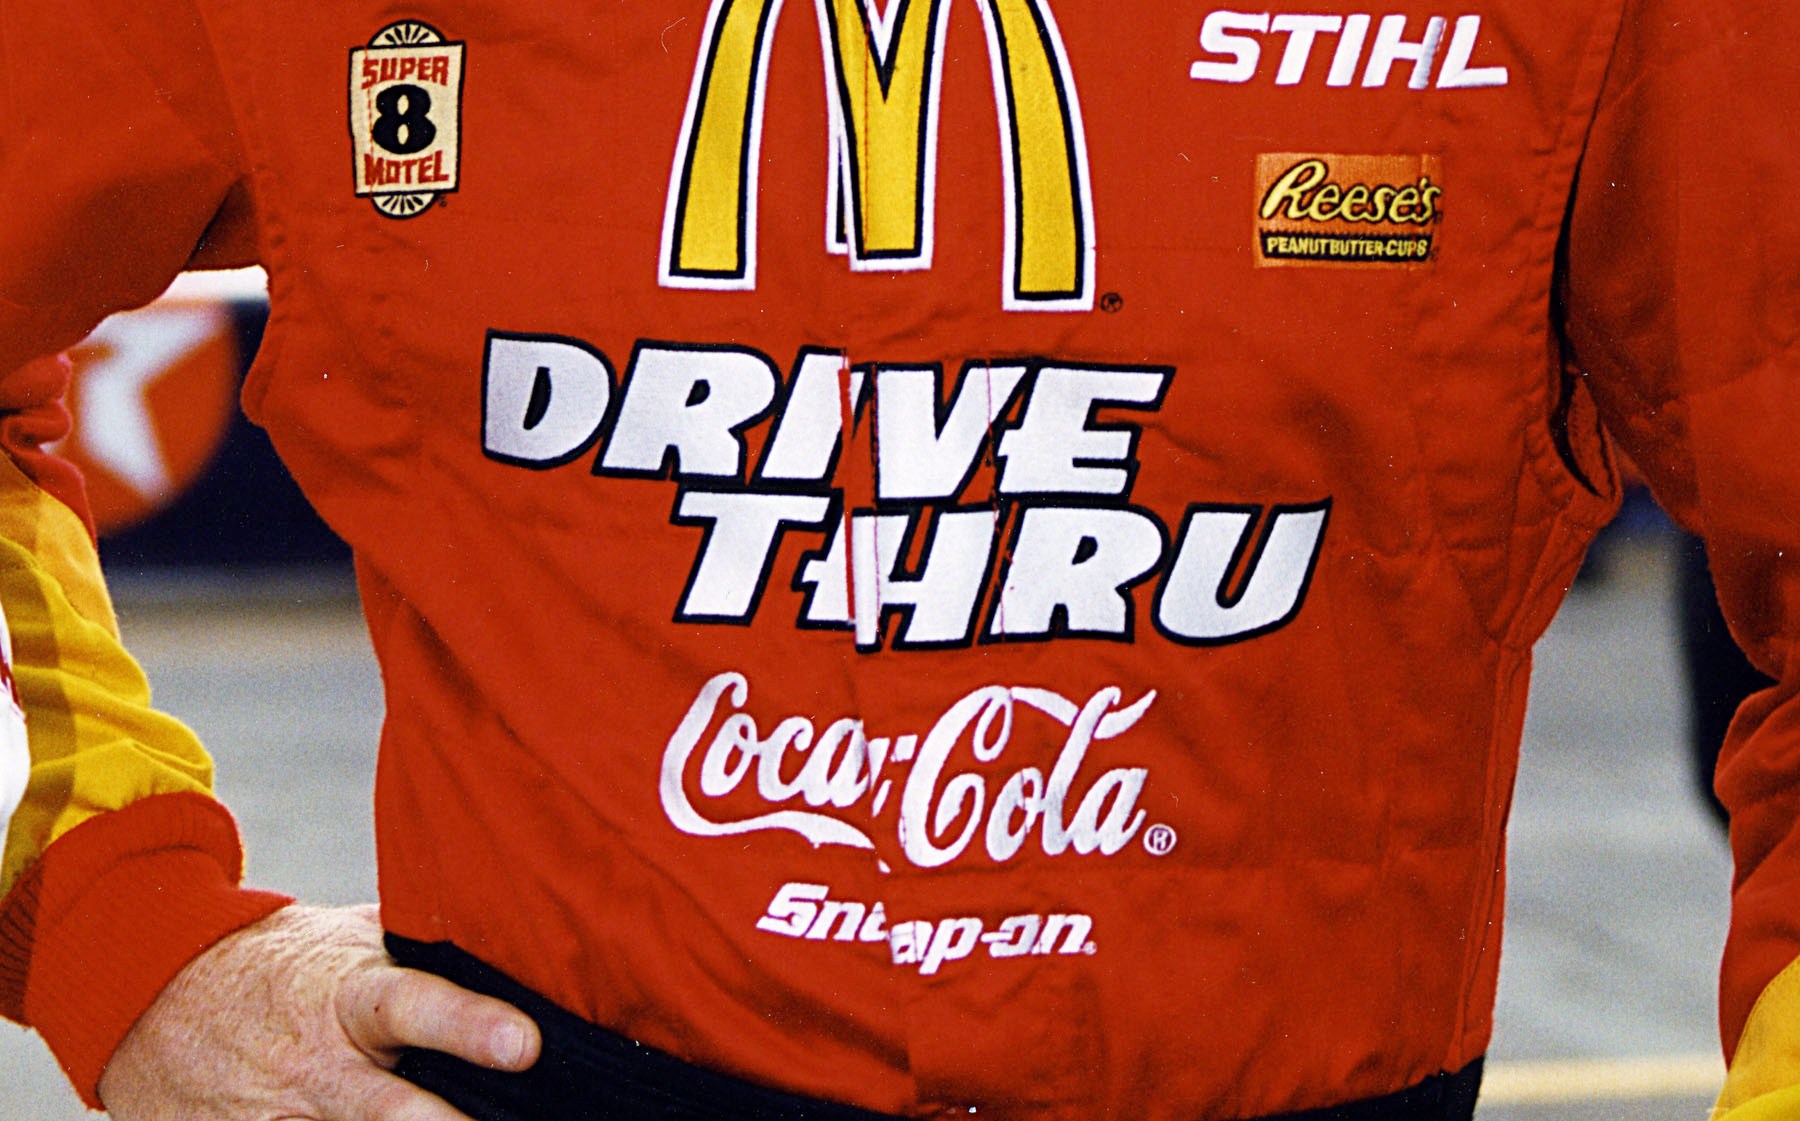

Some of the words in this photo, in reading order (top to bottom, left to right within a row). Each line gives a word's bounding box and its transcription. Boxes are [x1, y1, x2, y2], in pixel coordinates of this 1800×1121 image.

[361, 56, 450, 88] SUPER
[1190, 10, 1508, 90] STIHL
[371, 83, 437, 155] 8
[363, 150, 450, 186] MOTEL
[1259, 158, 1442, 225] Reese's
[1266, 236, 1327, 255] PEANUT
[481, 329, 1175, 506] DRIVE
[669, 485, 1333, 652] THRU
[658, 670, 1157, 868] Coca-Cola
